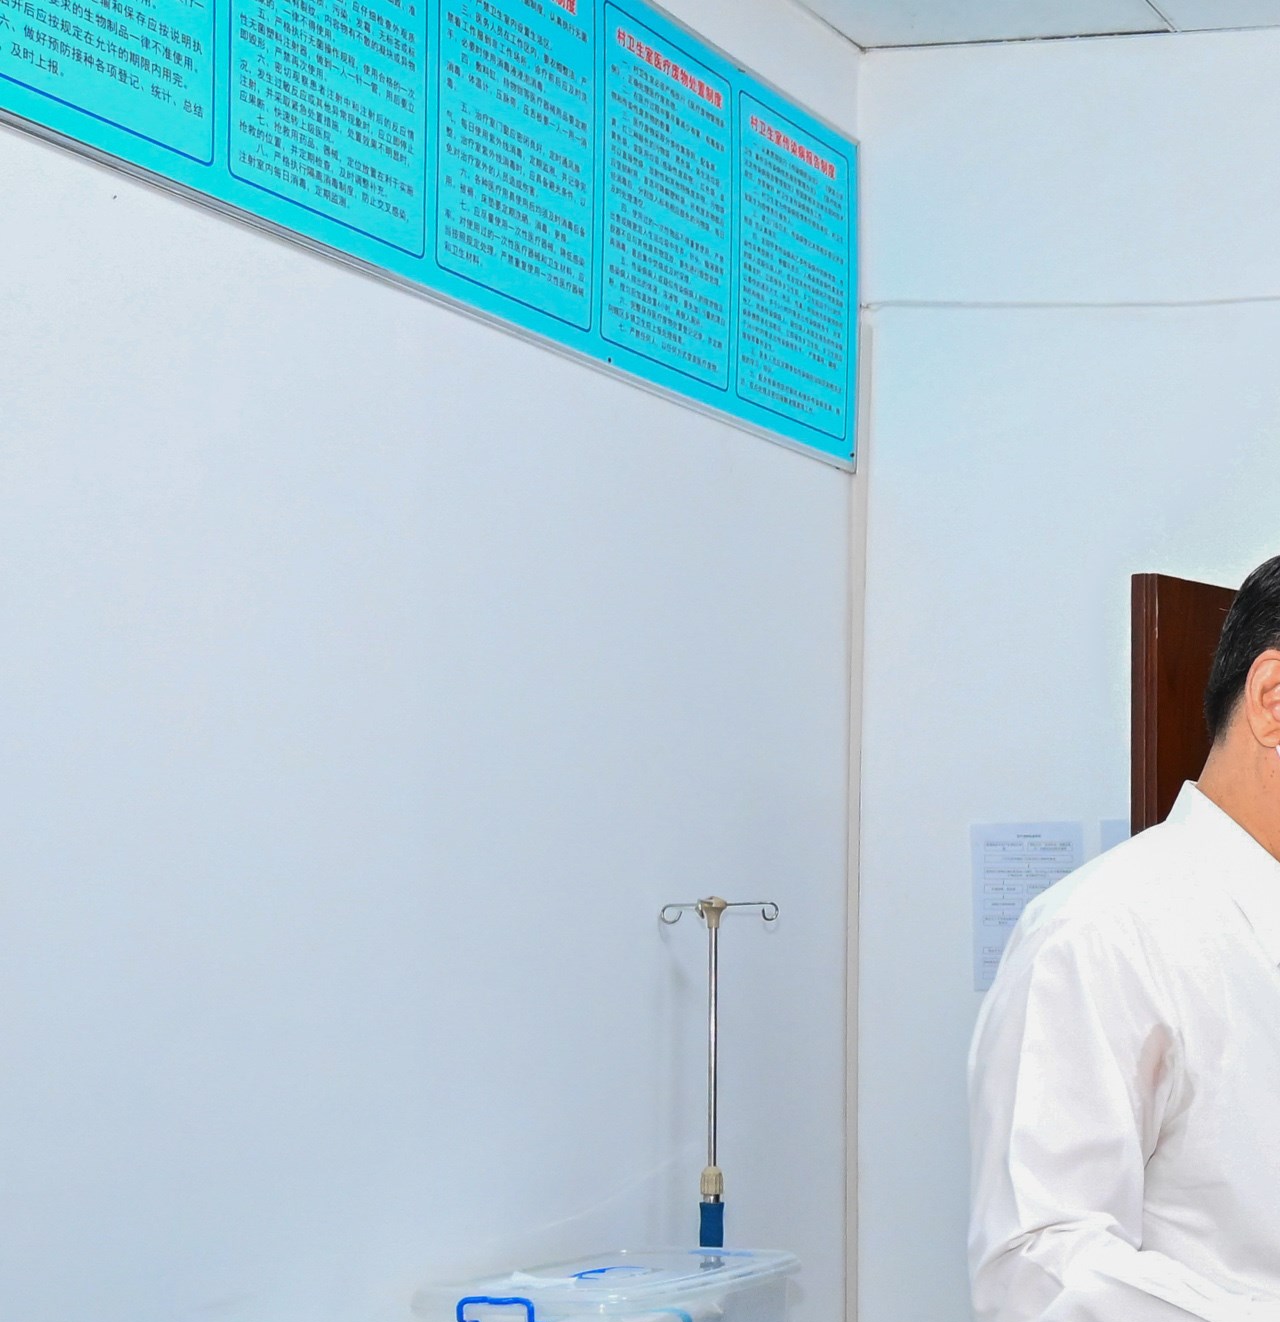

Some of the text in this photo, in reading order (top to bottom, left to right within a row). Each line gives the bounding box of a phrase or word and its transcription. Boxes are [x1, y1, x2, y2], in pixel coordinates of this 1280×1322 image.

[616, 27, 721, 109] 村卫生室医疗废物处置制度
[750, 112, 834, 180] 村卫生室传染病报告制度
